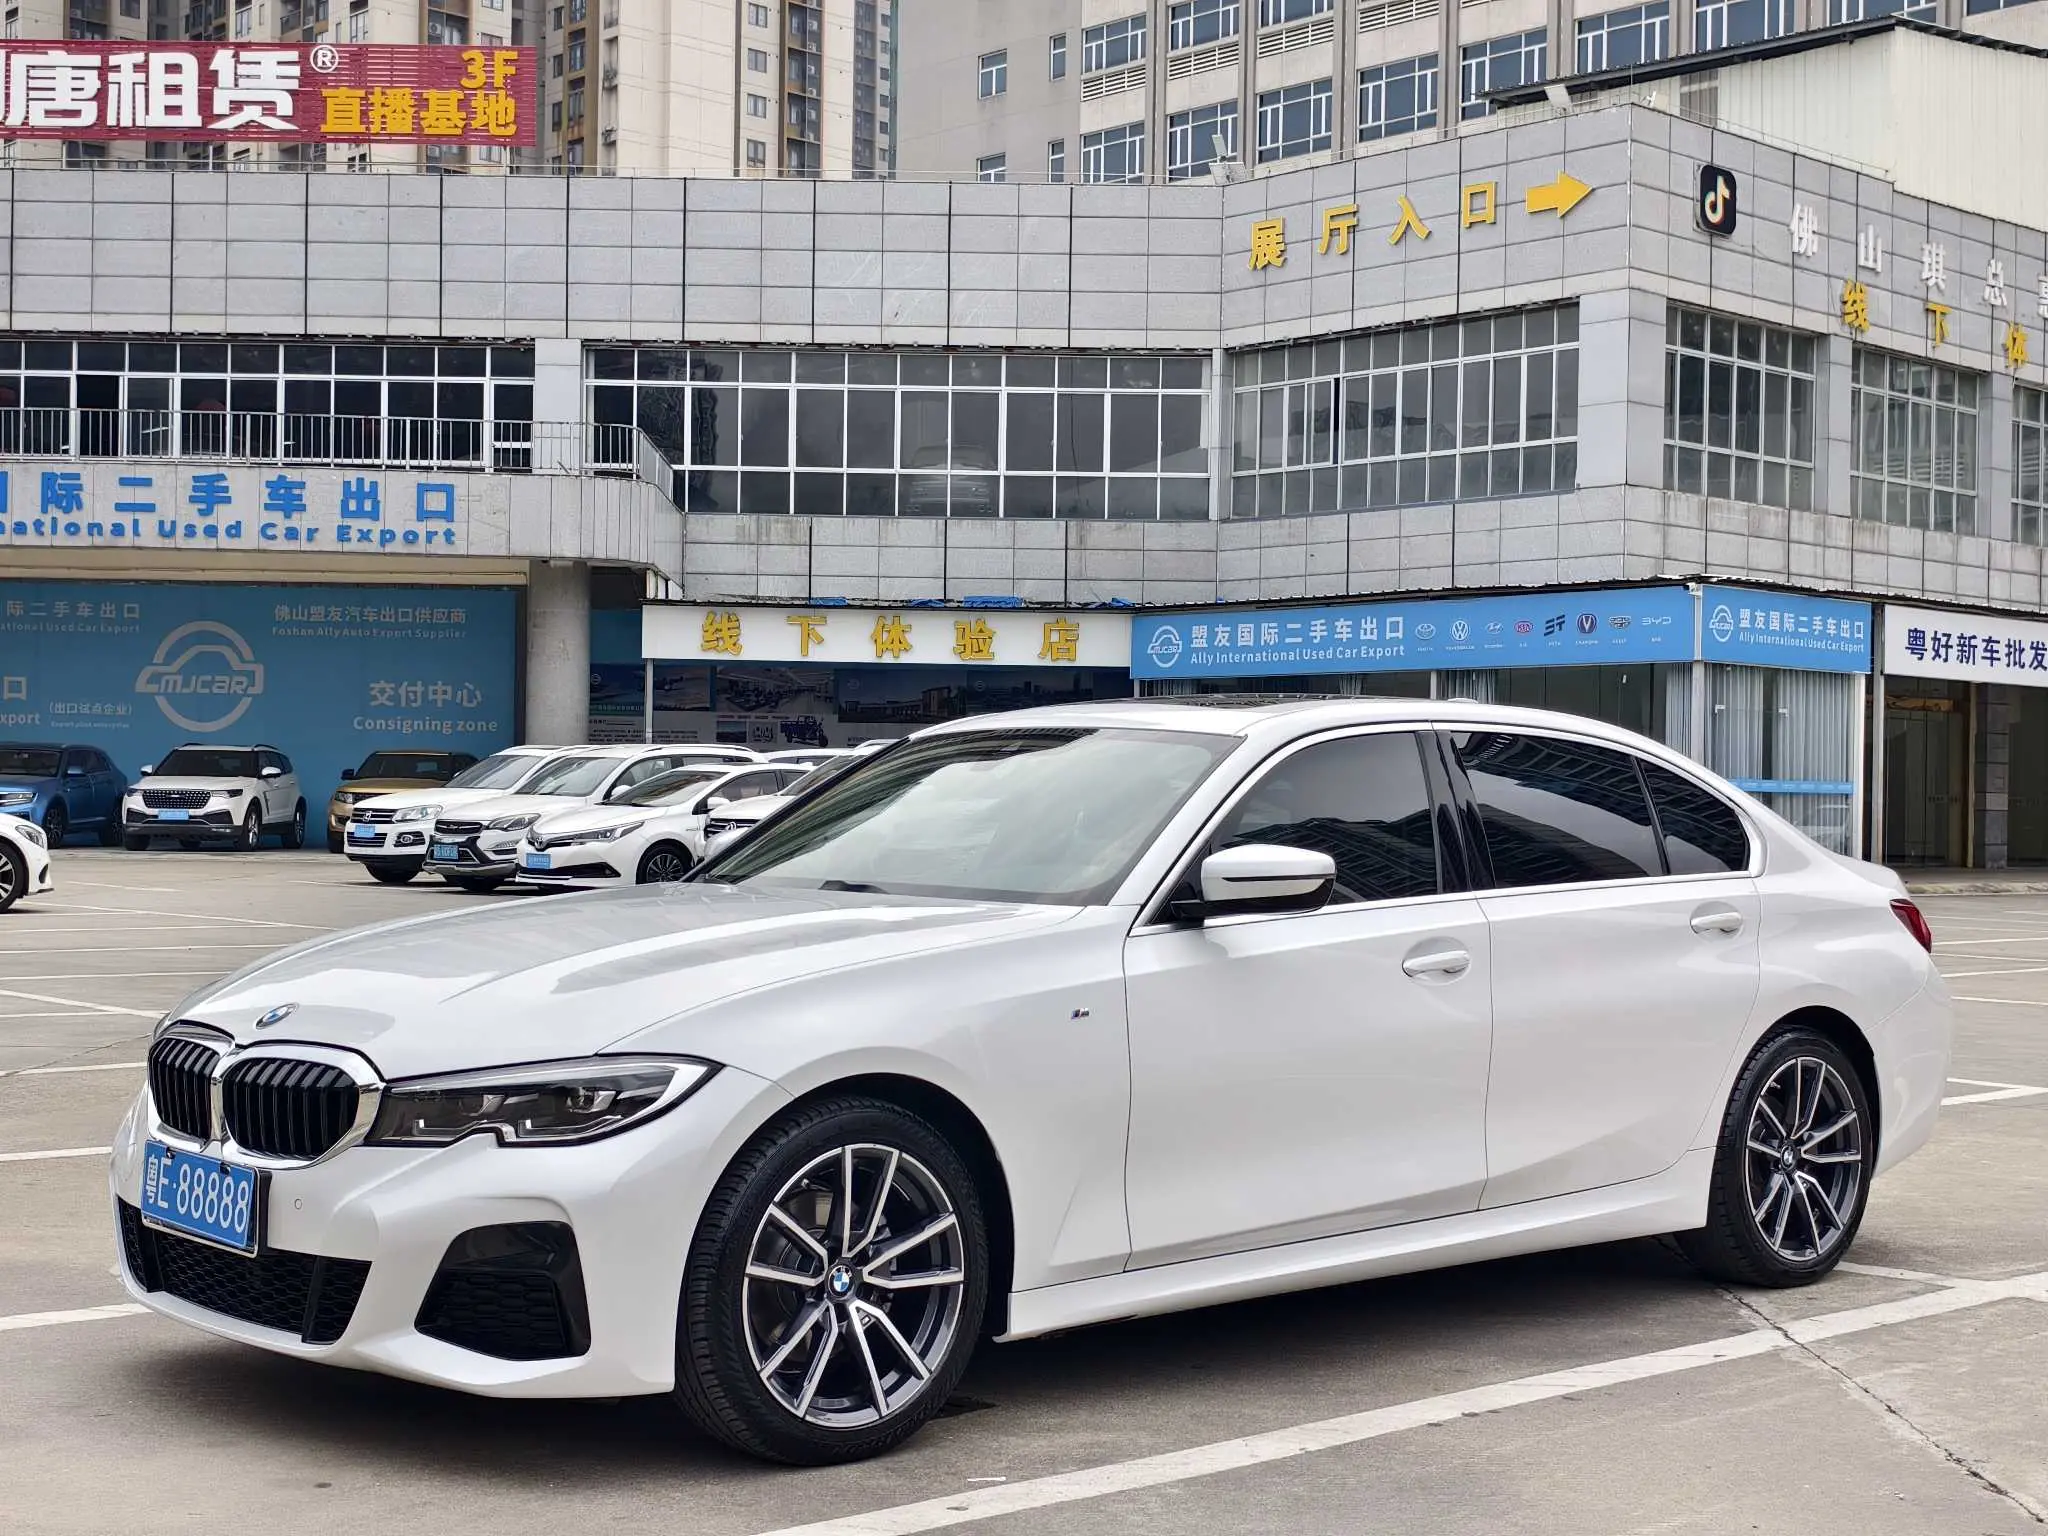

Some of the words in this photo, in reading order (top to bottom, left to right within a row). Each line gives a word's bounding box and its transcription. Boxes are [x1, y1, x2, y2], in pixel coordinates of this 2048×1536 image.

[461, 49, 518, 89] 3F
[0, 48, 300, 131] 唐租赁
[320, 89, 517, 137] 直播基地
[1249, 181, 1497, 270] 展厅入口
[1842, 279, 2029, 368] 线下体
[0, 470, 455, 523] 际二手车出口
[157, 520, 242, 539] Used
[260, 522, 319, 542] Car
[337, 525, 456, 547] Export
[47, 622, 75, 633] Used
[78, 623, 96, 633] Car
[101, 623, 140, 636] Export
[274, 604, 467, 624] 佛山盟友汽车出口供应商
[1739, 608, 1864, 640] 盟友国际二手车出口
[272, 626, 315, 637] Foshan
[342, 628, 370, 638] Auto
[372, 628, 413, 639] Export
[415, 629, 467, 640] Supplier
[700, 611, 1080, 662] 线下体验店
[1190, 616, 1404, 648] 盟友国际二手车出口
[1739, 632, 1754, 645] Ally
[1756, 634, 1808, 648] International
[1809, 637, 1826, 649] Used
[1828, 641, 1840, 651] Car
[1841, 641, 1864, 654] Export
[1190, 651, 1214, 666] Ally
[1216, 648, 1300, 664] International
[1303, 648, 1333, 661] Used
[1337, 648, 1358, 659] Car
[1361, 645, 1405, 661] Export
[1905, 627, 2048, 672] 粤好新车批发
[3, 677, 27, 700] 口
[369, 680, 482, 708] 交付中心
[353, 716, 452, 735] Consigning
[456, 719, 498, 732] zone
